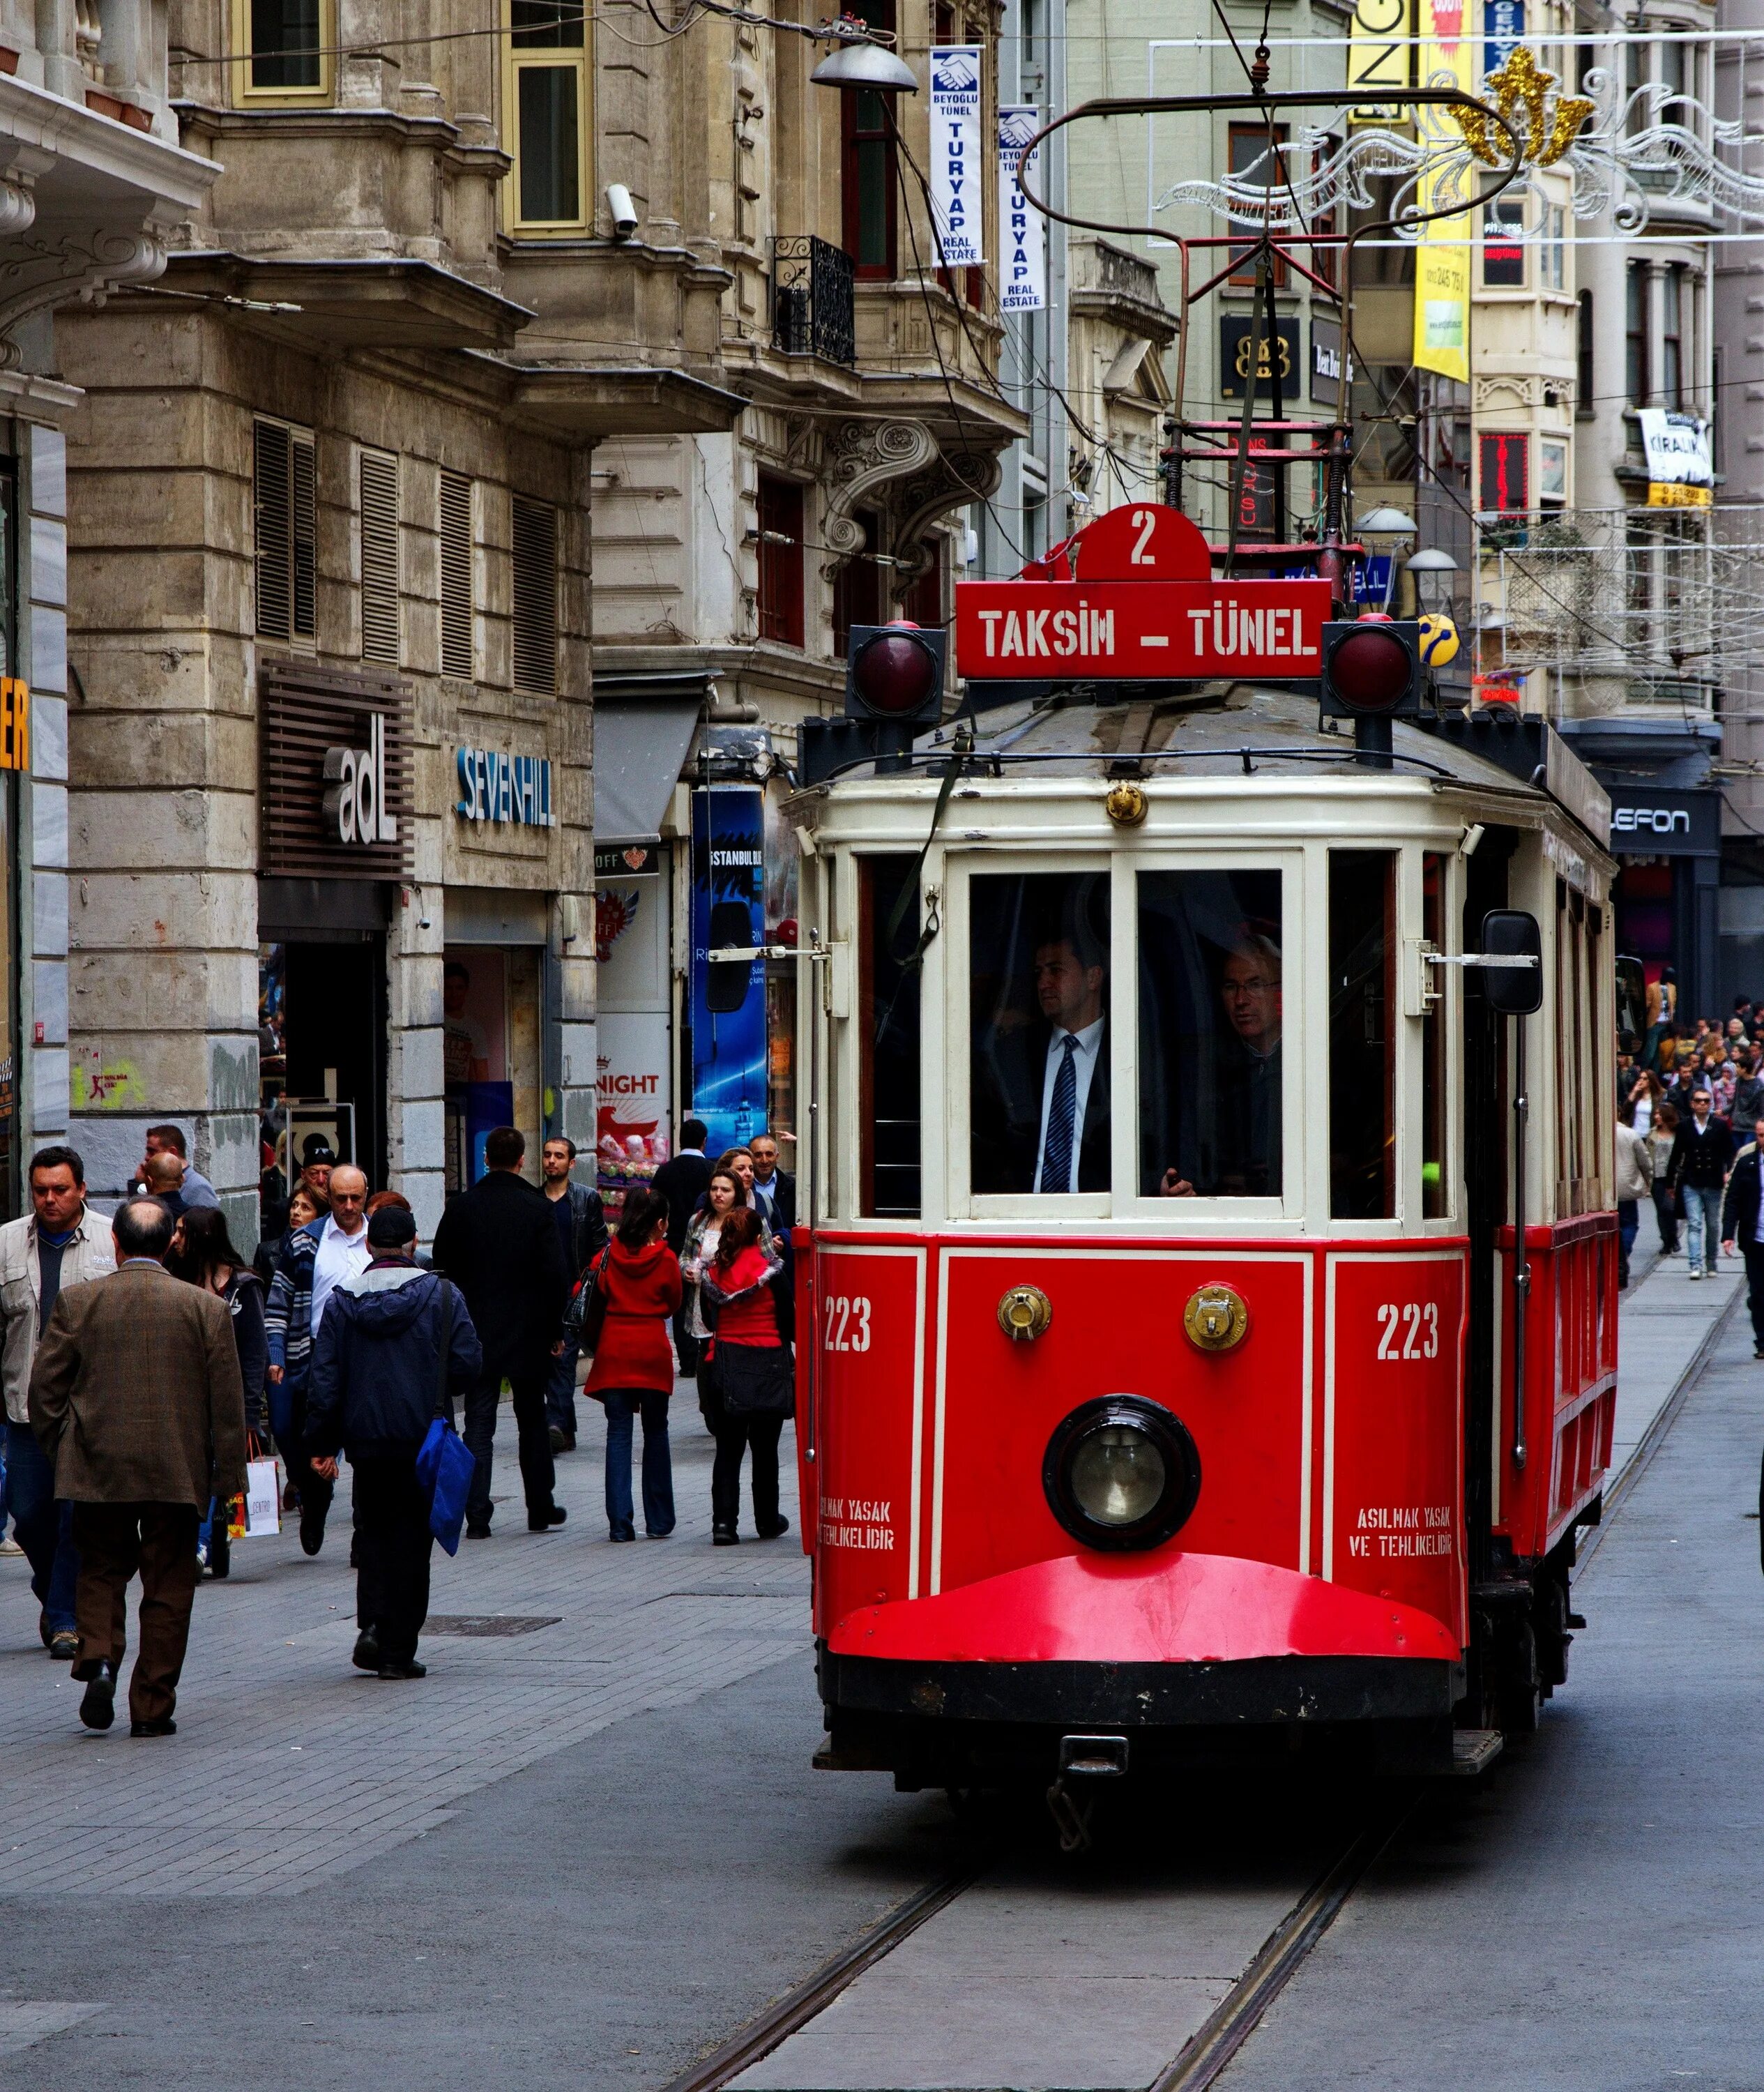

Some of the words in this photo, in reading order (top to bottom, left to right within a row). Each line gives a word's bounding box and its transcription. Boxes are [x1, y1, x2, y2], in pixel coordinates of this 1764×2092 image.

[934, 92, 978, 103] BEYOĞLU
[941, 106, 971, 115] TÜNEL
[999, 150, 1038, 160] BEYOLU
[948, 122, 965, 232] TURYAP
[1011, 178, 1028, 280] TURYAP
[943, 238, 971, 248] REAL
[1003, 296, 1040, 307] ESTATE
[1008, 285, 1034, 295] REAL
[1131, 510, 1155, 565] 2
[978, 600, 1114, 657] TAKSİM
[1187, 600, 1318, 656] TÜNEL
[0, 676, 29, 771] ER
[825, 1296, 871, 1351] 223
[1377, 1302, 1438, 1360] 223
[849, 1499, 890, 1522] YASAK
[1358, 1508, 1419, 1529] ASILMAK
[1424, 1506, 1450, 1528] YASAK
[1349, 1536, 1371, 1557] VE
[1378, 1531, 1452, 1556] TEHLİKELİDİR
